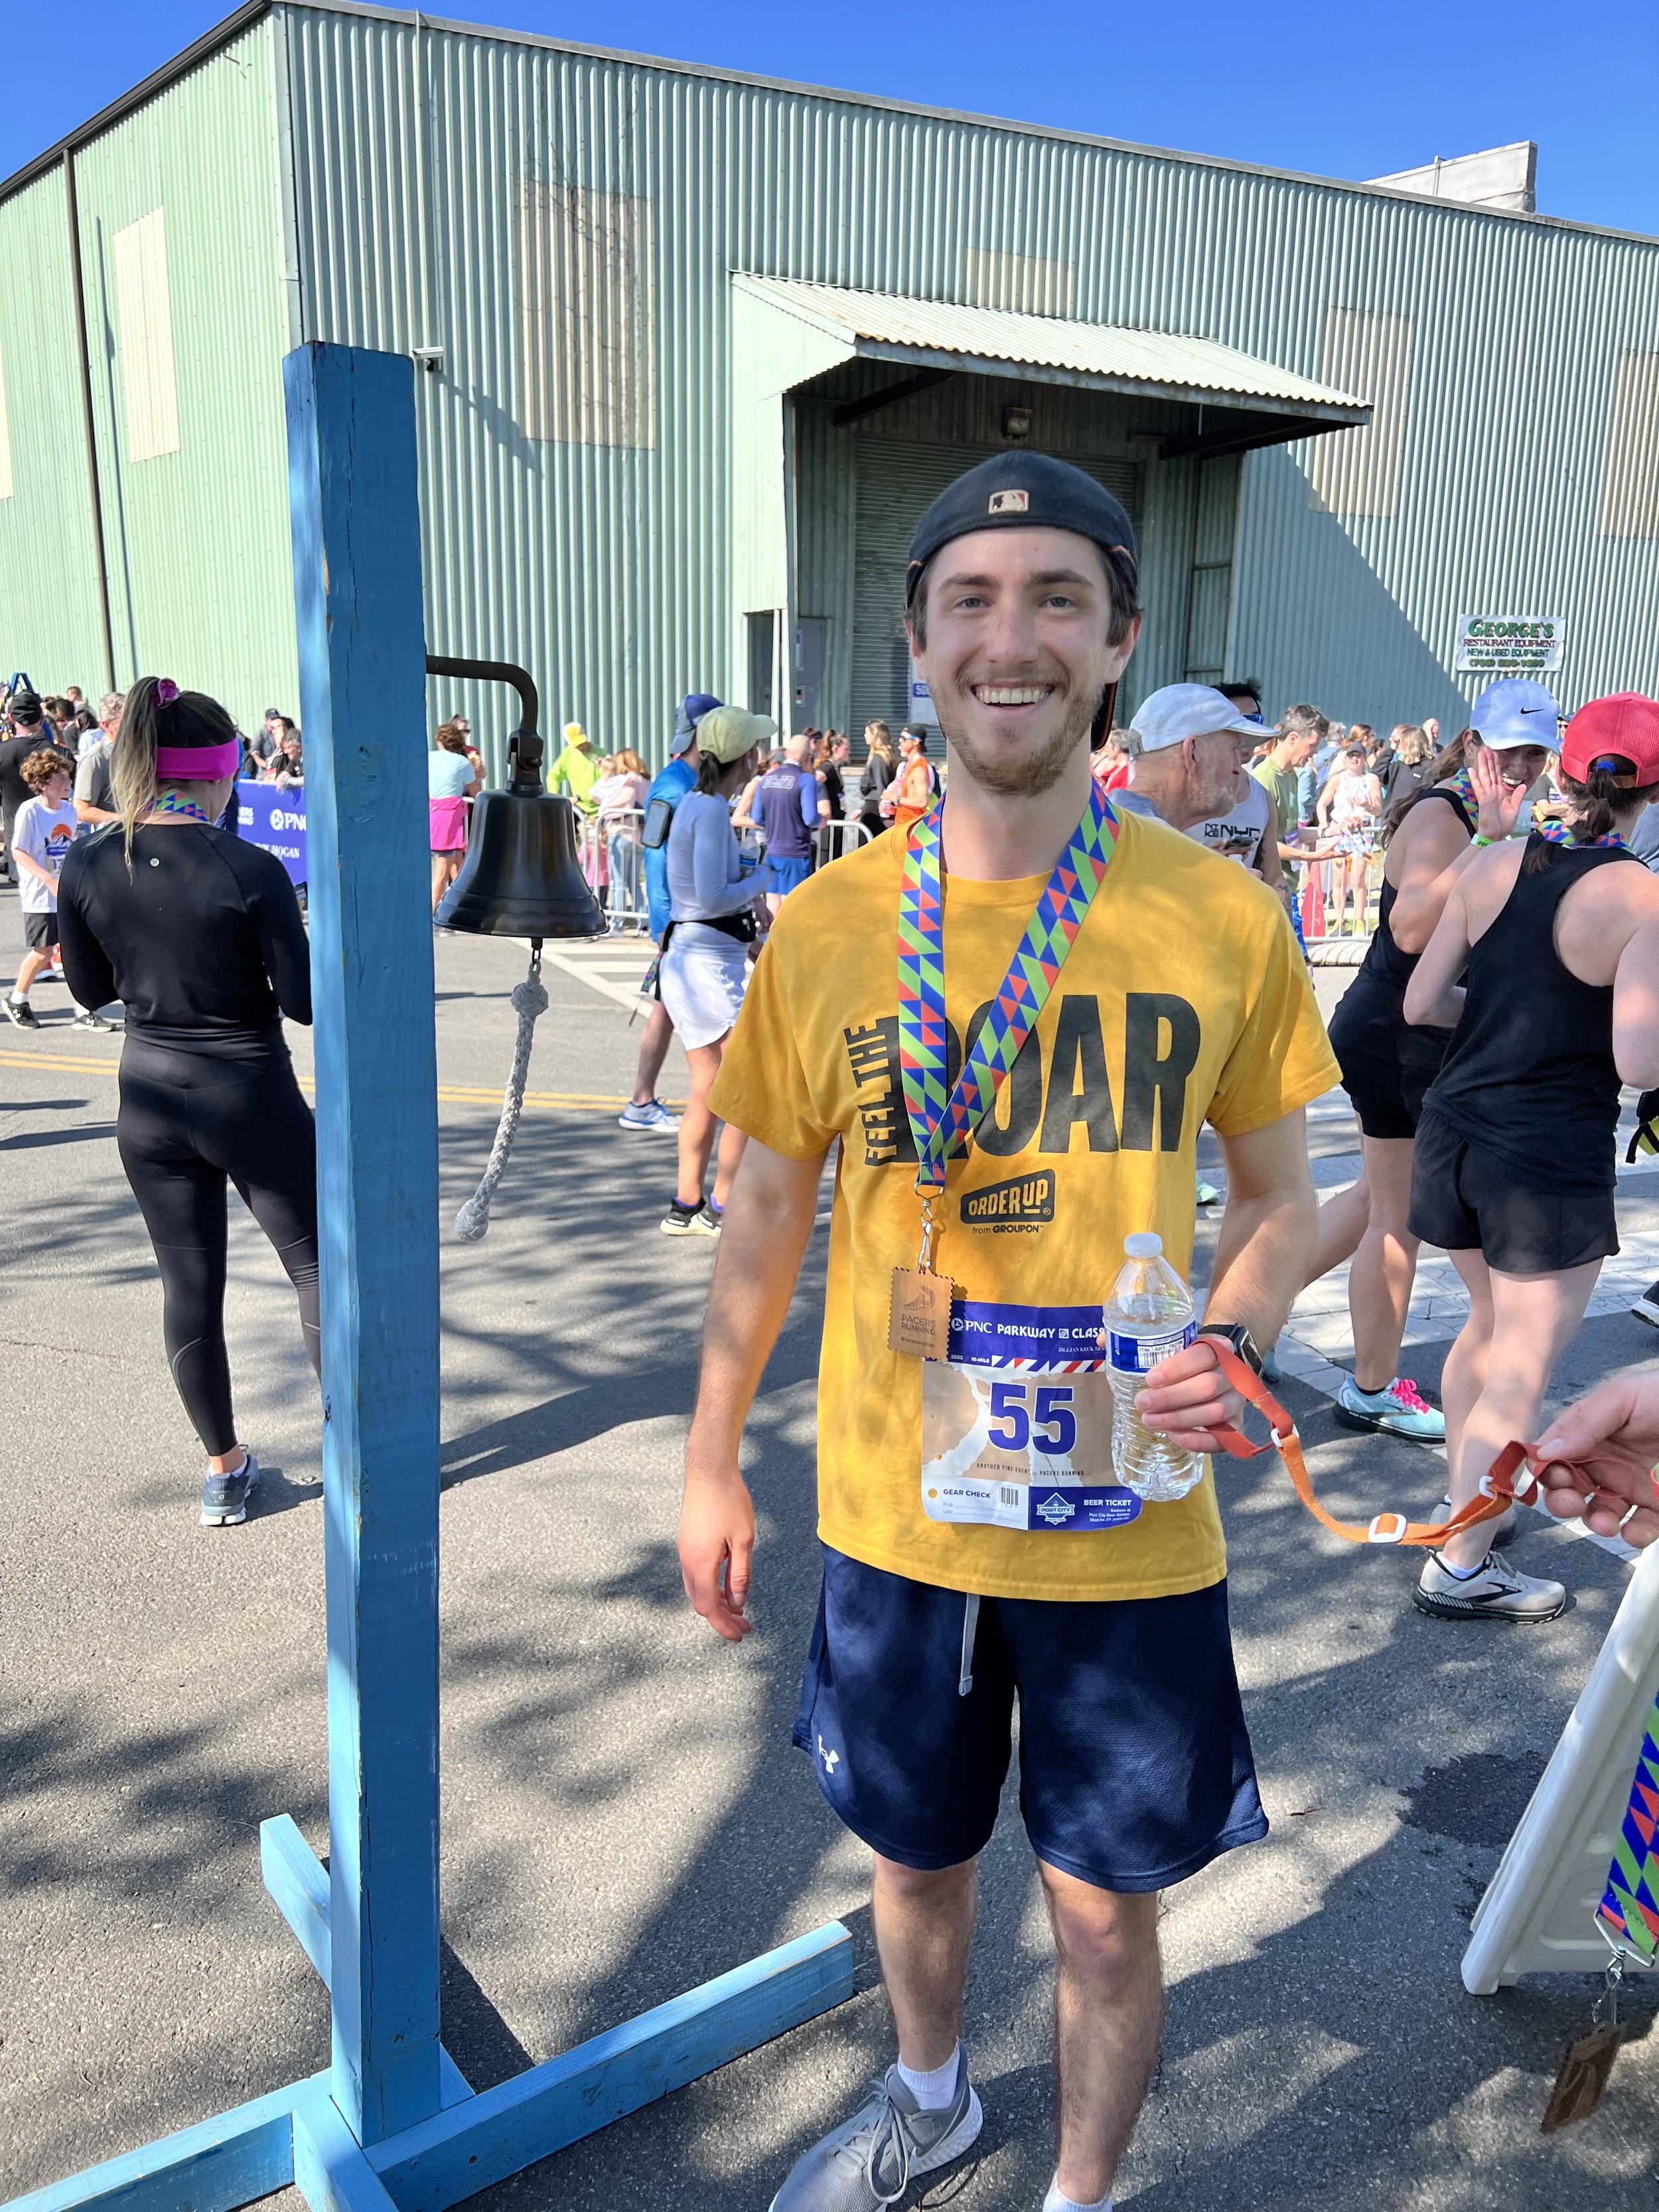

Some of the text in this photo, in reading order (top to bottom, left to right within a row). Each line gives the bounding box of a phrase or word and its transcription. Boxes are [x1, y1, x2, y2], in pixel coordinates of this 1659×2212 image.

[1469, 619, 1554, 638] GEORGE'S
[1492, 648, 1510, 657] USED
[1512, 648, 1550, 658] EQUIPMENT
[843, 1019, 898, 1167] FEEL THE
[901, 1314, 936, 1328] PACERS
[901, 1322, 936, 1335] RUNNING
[964, 1320, 993, 1334] PNC
[997, 1324, 1056, 1339] PARKWAY
[987, 1382, 1076, 1455] 55
[966, 1490, 991, 1499] CHECK
